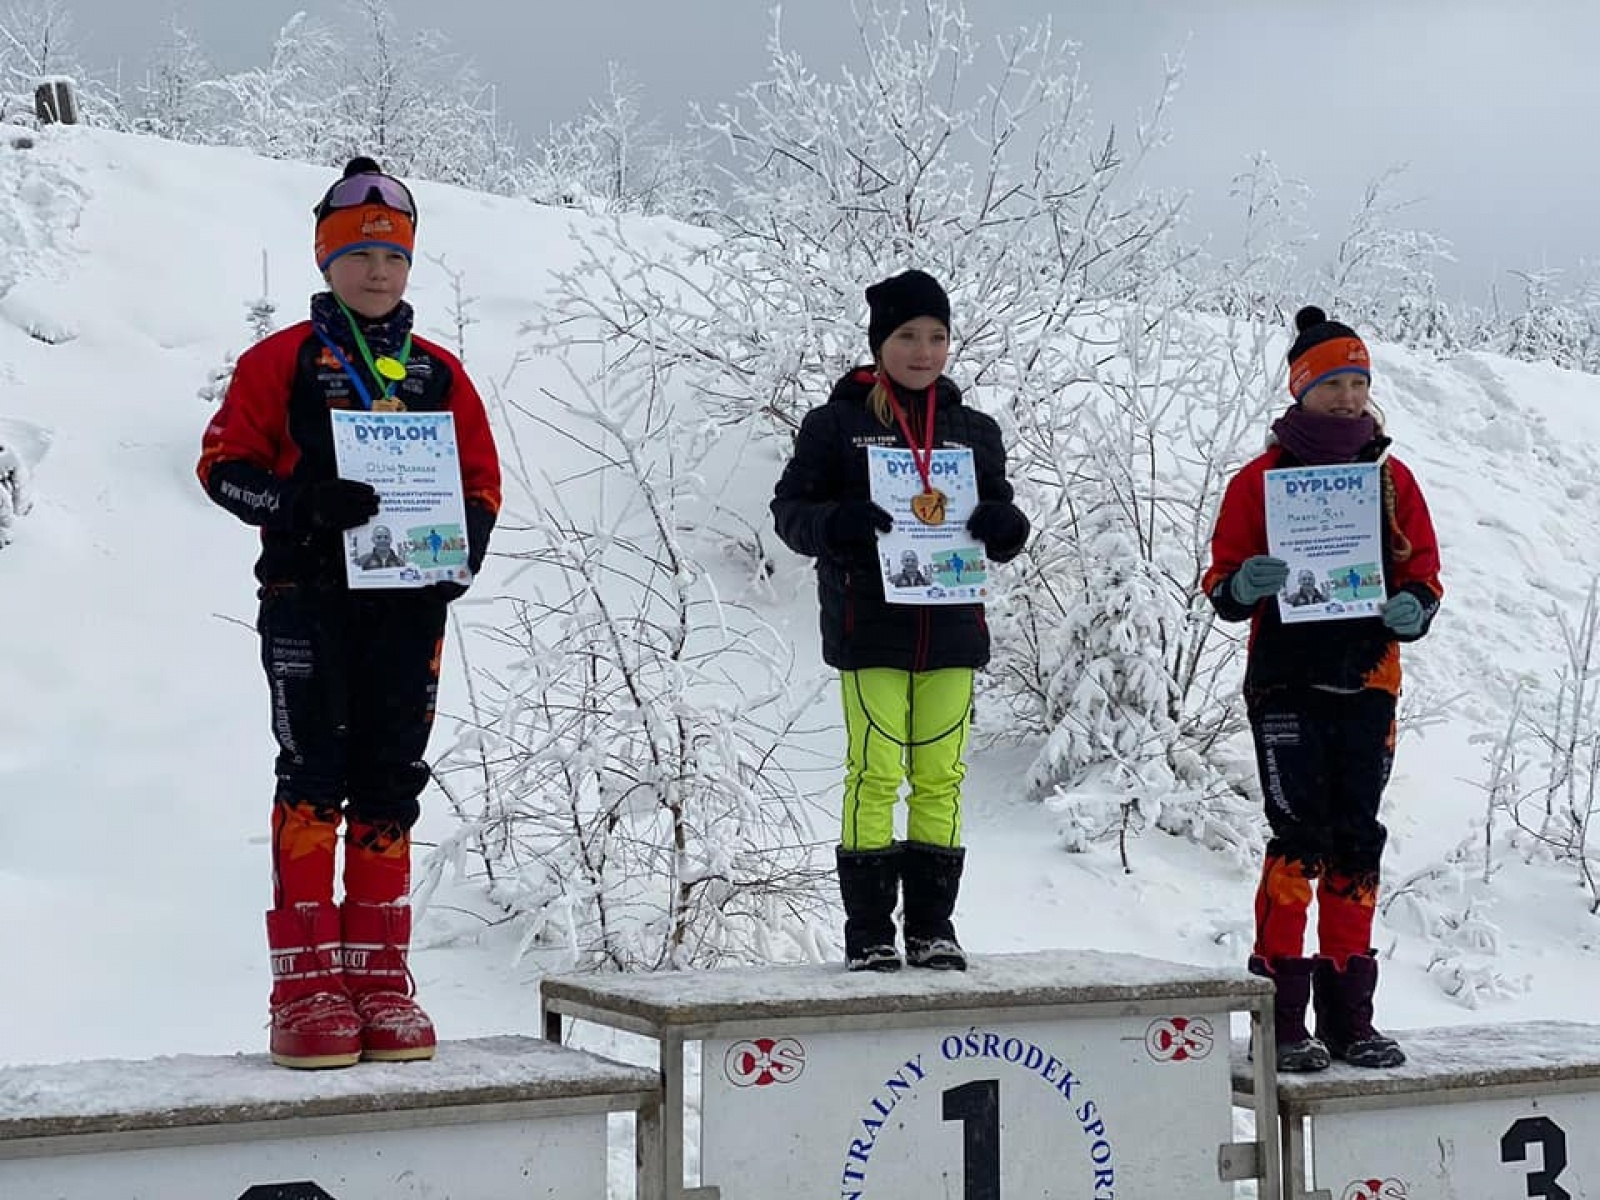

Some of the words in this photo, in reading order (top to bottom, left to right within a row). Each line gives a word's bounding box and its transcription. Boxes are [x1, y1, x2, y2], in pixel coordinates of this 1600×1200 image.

[354, 425, 437, 441] DYPLOM
[887, 460, 959, 475] DYOM
[1286, 476, 1363, 494] DYPLOM
[942, 1027, 1081, 1100] OŚRODEK
[943, 1079, 1000, 1200] 1
[1501, 1116, 1570, 1200] 3
